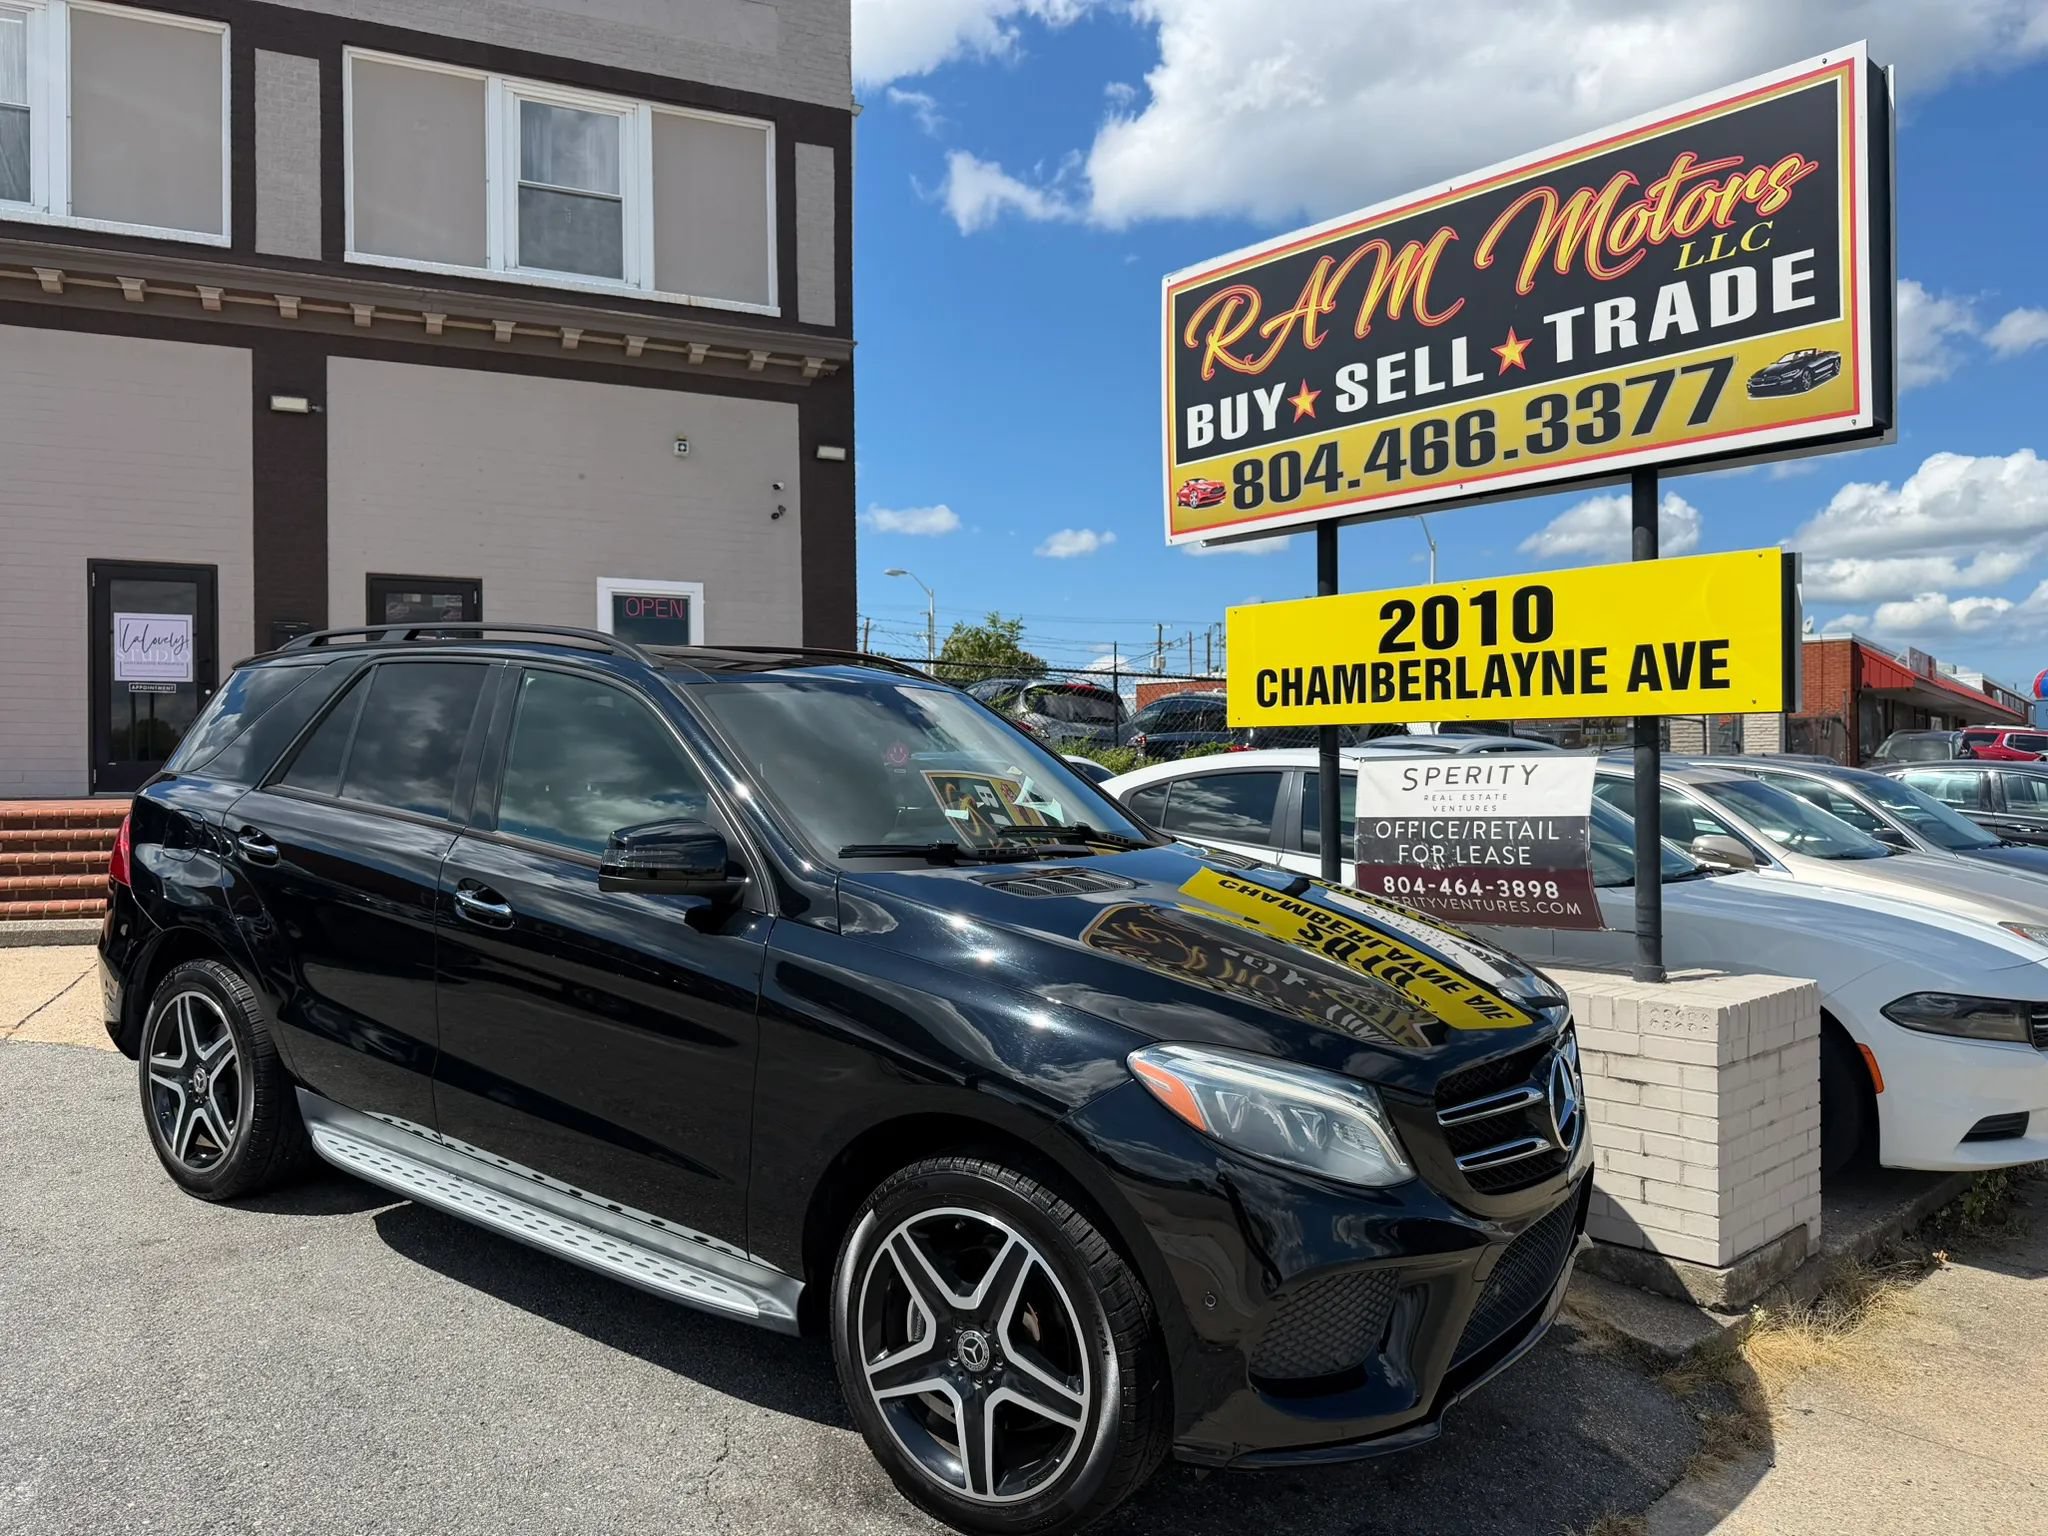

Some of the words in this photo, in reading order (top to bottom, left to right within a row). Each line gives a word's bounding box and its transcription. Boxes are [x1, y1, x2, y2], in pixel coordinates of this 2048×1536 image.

[1673, 220, 1774, 271] LLC
[1184, 226, 1465, 382] RAM
[1473, 151, 1819, 295] Motors
[1186, 382, 1287, 450] BUY
[1335, 336, 1484, 413] SELL
[1543, 248, 1816, 364] TRADE
[1232, 354, 1738, 511] 804.466.3377
[625, 597, 683, 618] OPEN
[1378, 585, 1554, 654] 2010
[1256, 647, 1608, 708] CHAMBERLAYNE
[1627, 639, 1730, 693] AVE
[1402, 764, 1538, 791] SPERITY
[1423, 793, 1454, 802] REAL
[1462, 793, 1509, 802] ESTATE
[1432, 804, 1498, 813] VENTURES
[1375, 820, 1560, 840] OFFICE/RETAIL
[1399, 844, 1445, 863] FOR
[1456, 846, 1532, 865] LEASE
[1383, 876, 1560, 899] 804-464-3898
[1388, 896, 1582, 916] ERITYVENTURES.COM
